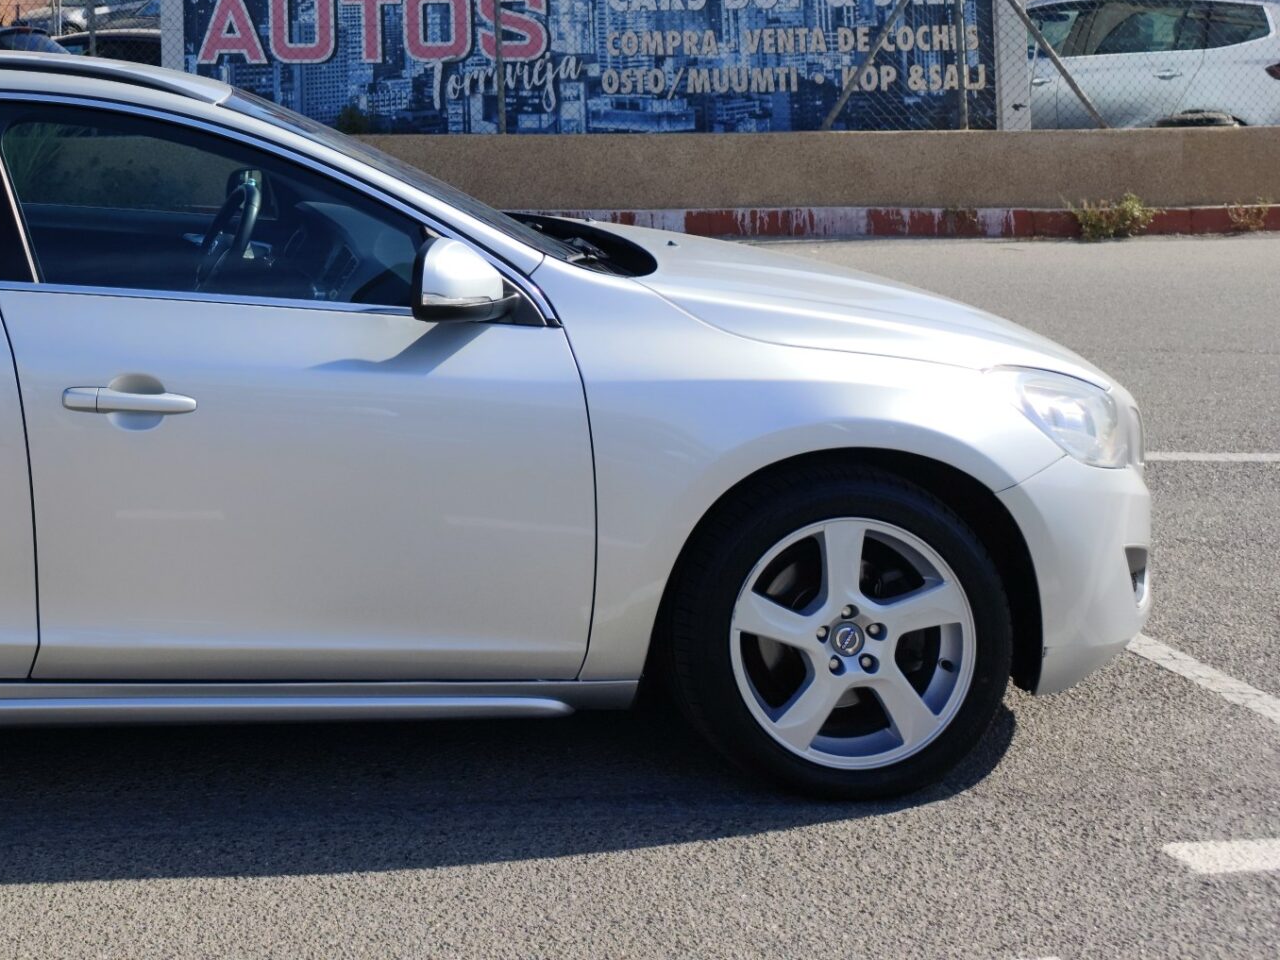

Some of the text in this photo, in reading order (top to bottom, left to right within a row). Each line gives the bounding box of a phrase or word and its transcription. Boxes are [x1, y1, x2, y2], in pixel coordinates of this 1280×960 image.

[606, 29, 720, 56] COMPRA
[746, 26, 828, 54] VENTA
[838, 26, 869, 52] DE
[601, 66, 798, 99] OSTO/MUUMTI
